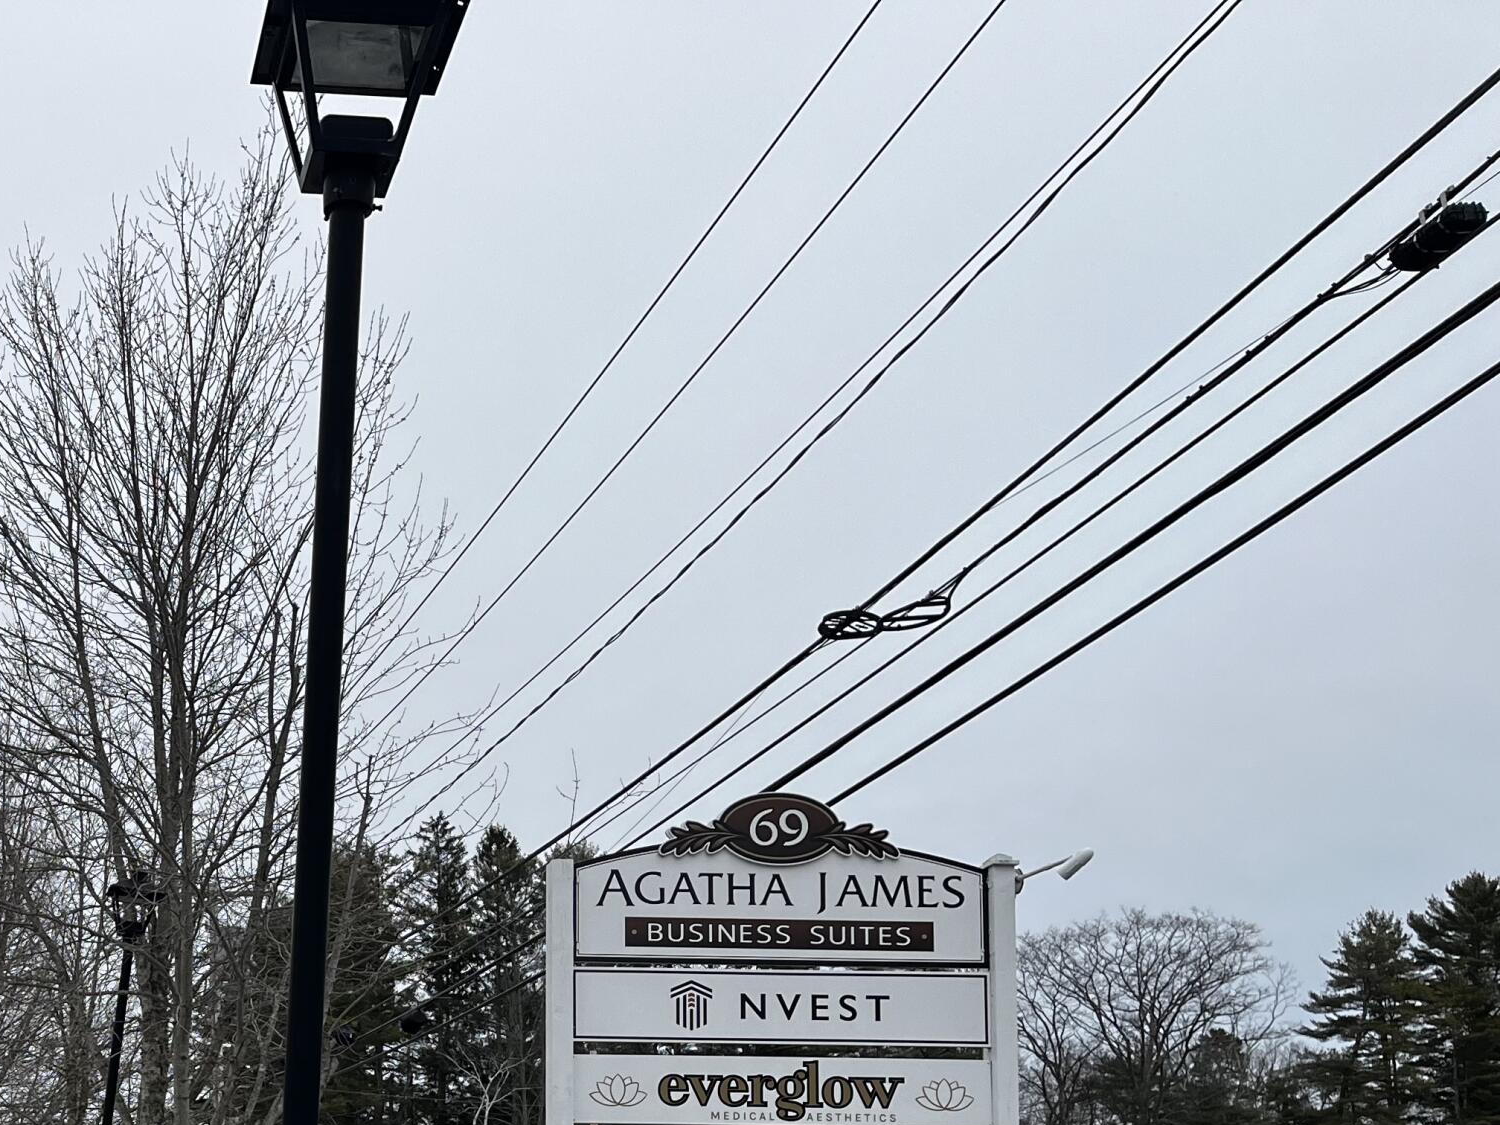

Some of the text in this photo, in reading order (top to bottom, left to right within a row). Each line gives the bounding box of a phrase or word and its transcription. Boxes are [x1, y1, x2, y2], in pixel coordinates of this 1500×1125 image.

[750, 808, 810, 847] 69
[596, 869, 966, 915] AGATHA JAMES
[647, 922, 912, 947] BUSINESS SUITES
[740, 993, 891, 1023] NVEST
[658, 1060, 905, 1122] everglow
[710, 1111, 898, 1123] MEDICAL AESTHETICS
